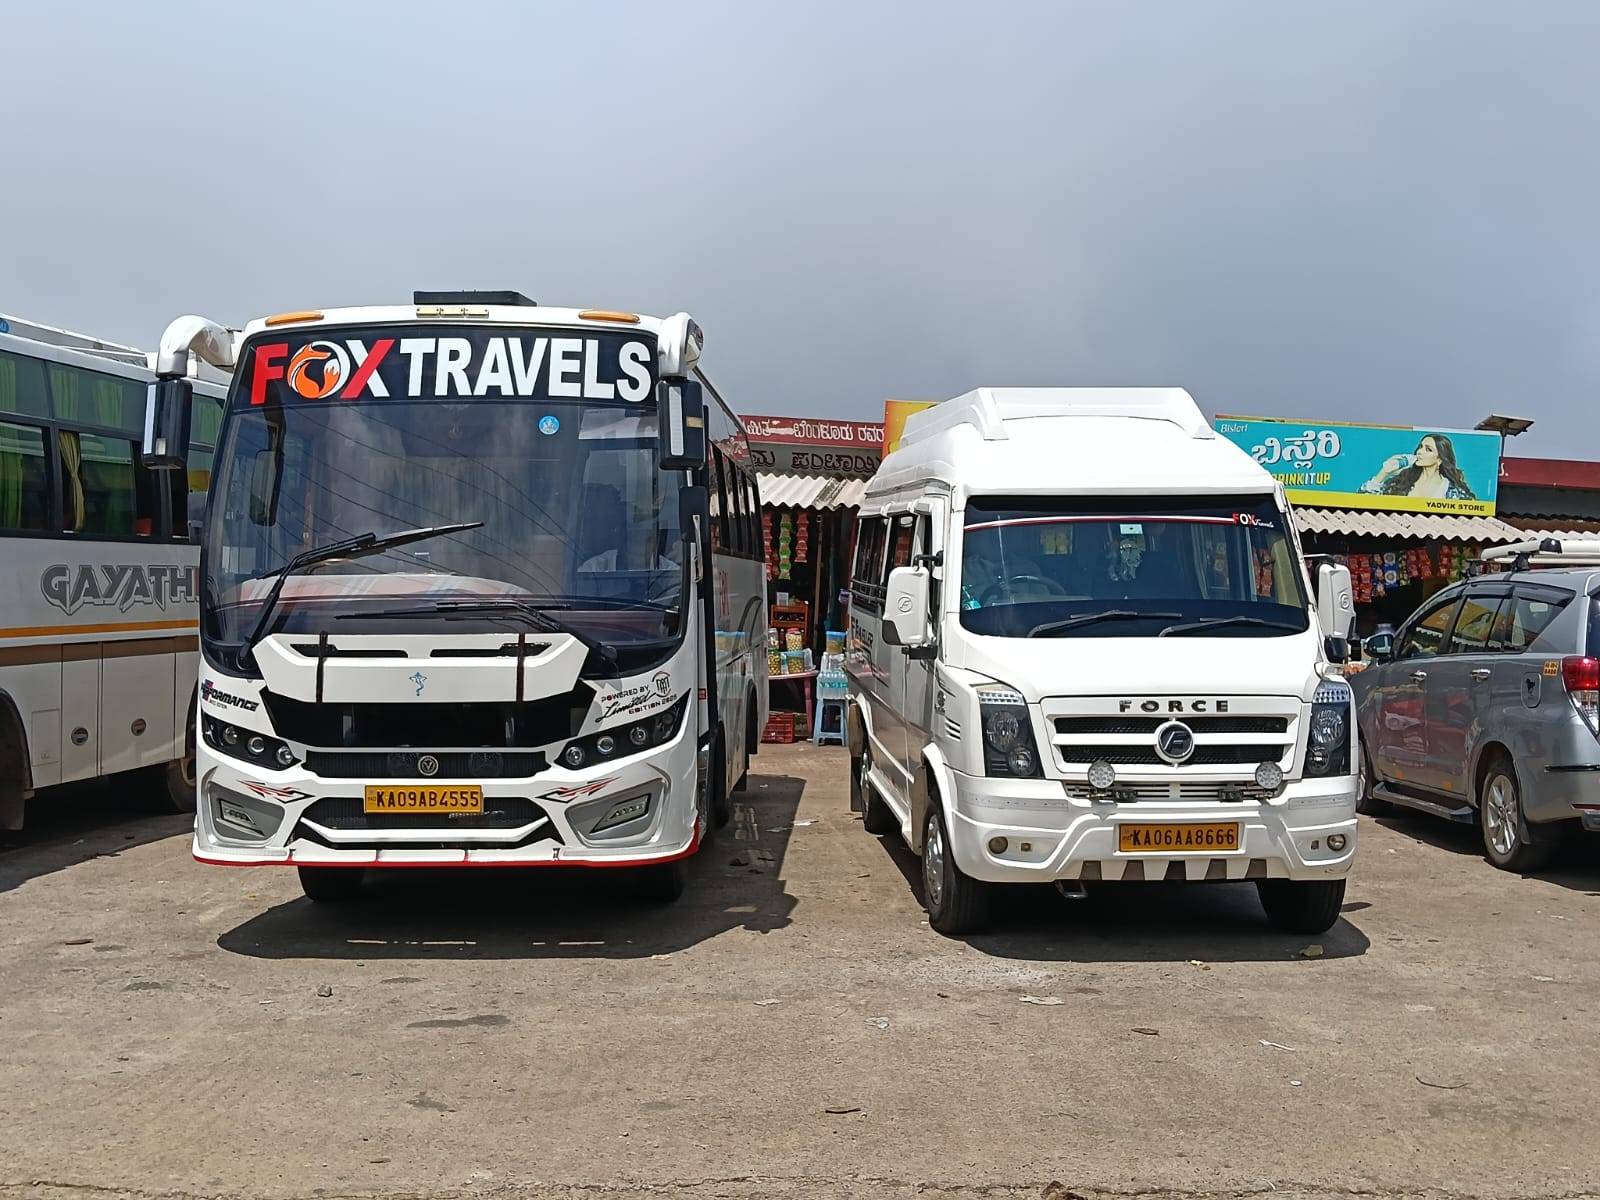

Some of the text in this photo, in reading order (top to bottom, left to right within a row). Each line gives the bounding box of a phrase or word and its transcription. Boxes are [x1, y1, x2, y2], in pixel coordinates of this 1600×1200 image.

[250, 337, 653, 405] FOX TRAVELS
[1220, 423, 1248, 433] Bisleri
[1426, 501, 1485, 512] YADVIK STORE
[1232, 512, 1256, 526] FOX
[41, 564, 199, 616] GAYATH
[601, 687, 638, 702] POWERED
[639, 684, 650, 693] BY
[628, 701, 661, 715] EDITION
[1119, 700, 1229, 713] FORCE
[376, 790, 480, 808] KA09AB4555
[1132, 829, 1235, 846] KA06AA8666
